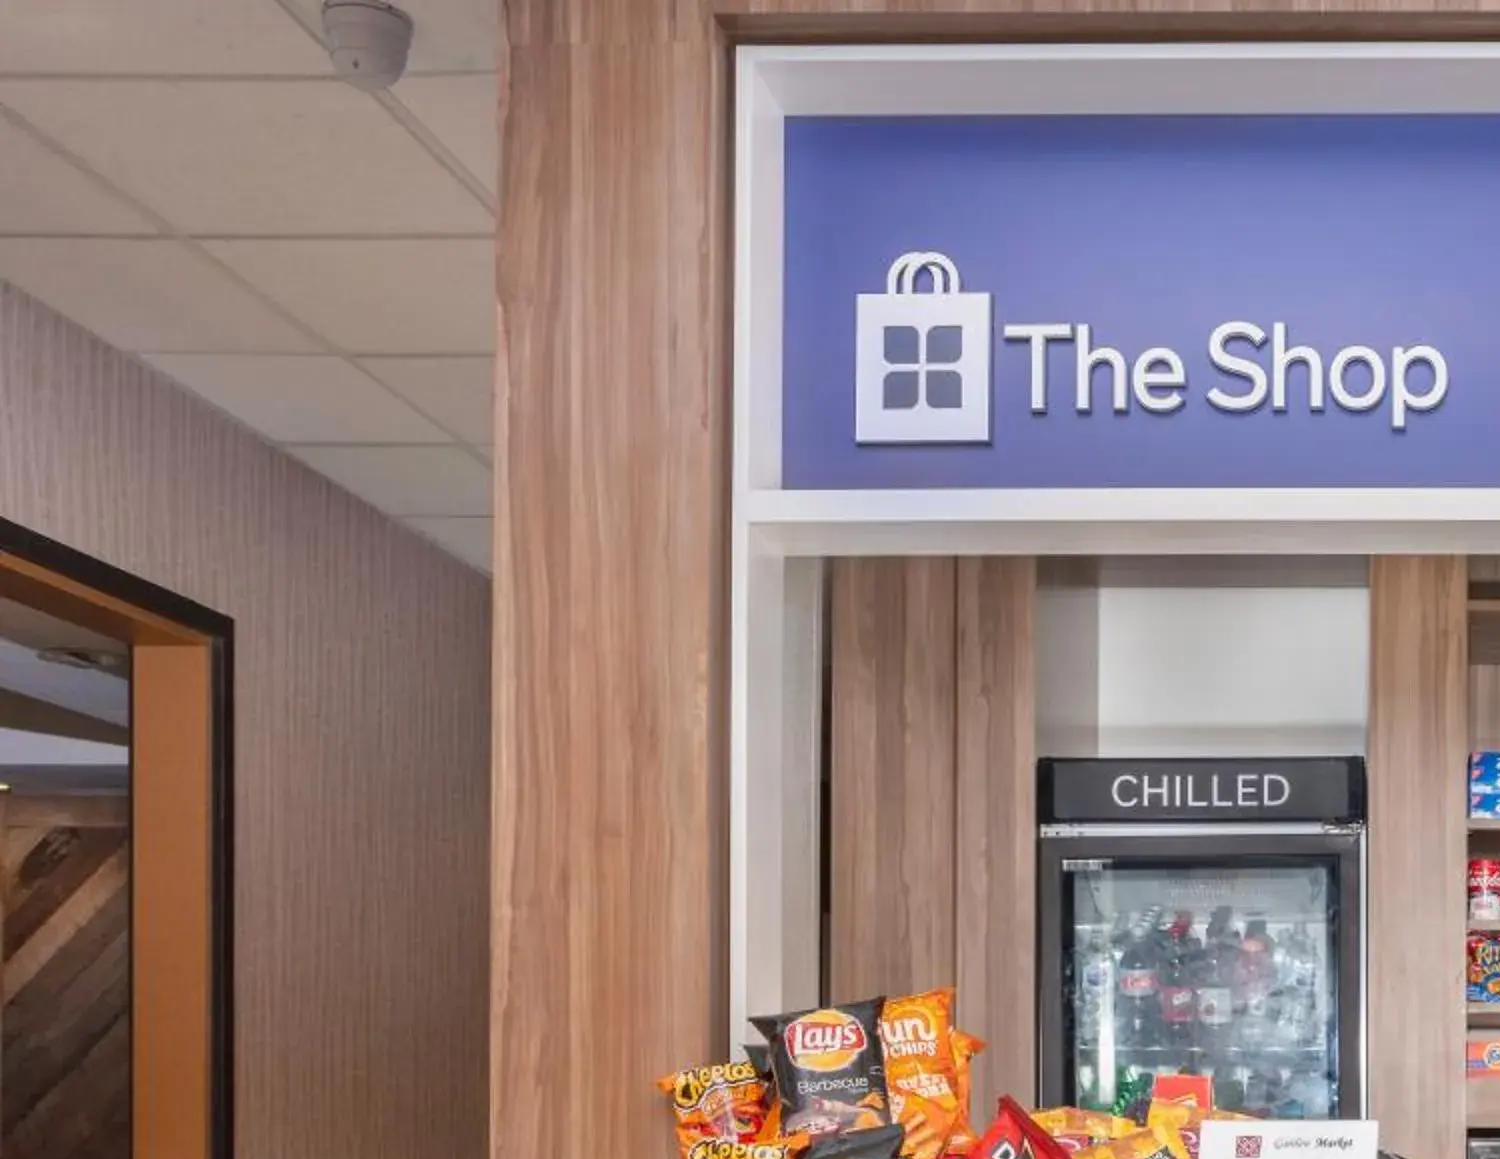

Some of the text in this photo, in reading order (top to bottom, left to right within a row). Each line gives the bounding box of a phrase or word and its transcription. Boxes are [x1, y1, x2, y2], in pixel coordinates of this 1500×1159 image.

[1003, 321, 1449, 431] The Shop
[1111, 774, 1291, 807] CHILLED
[879, 1017, 937, 1043] un
[797, 1077, 869, 1094] Barbecue
